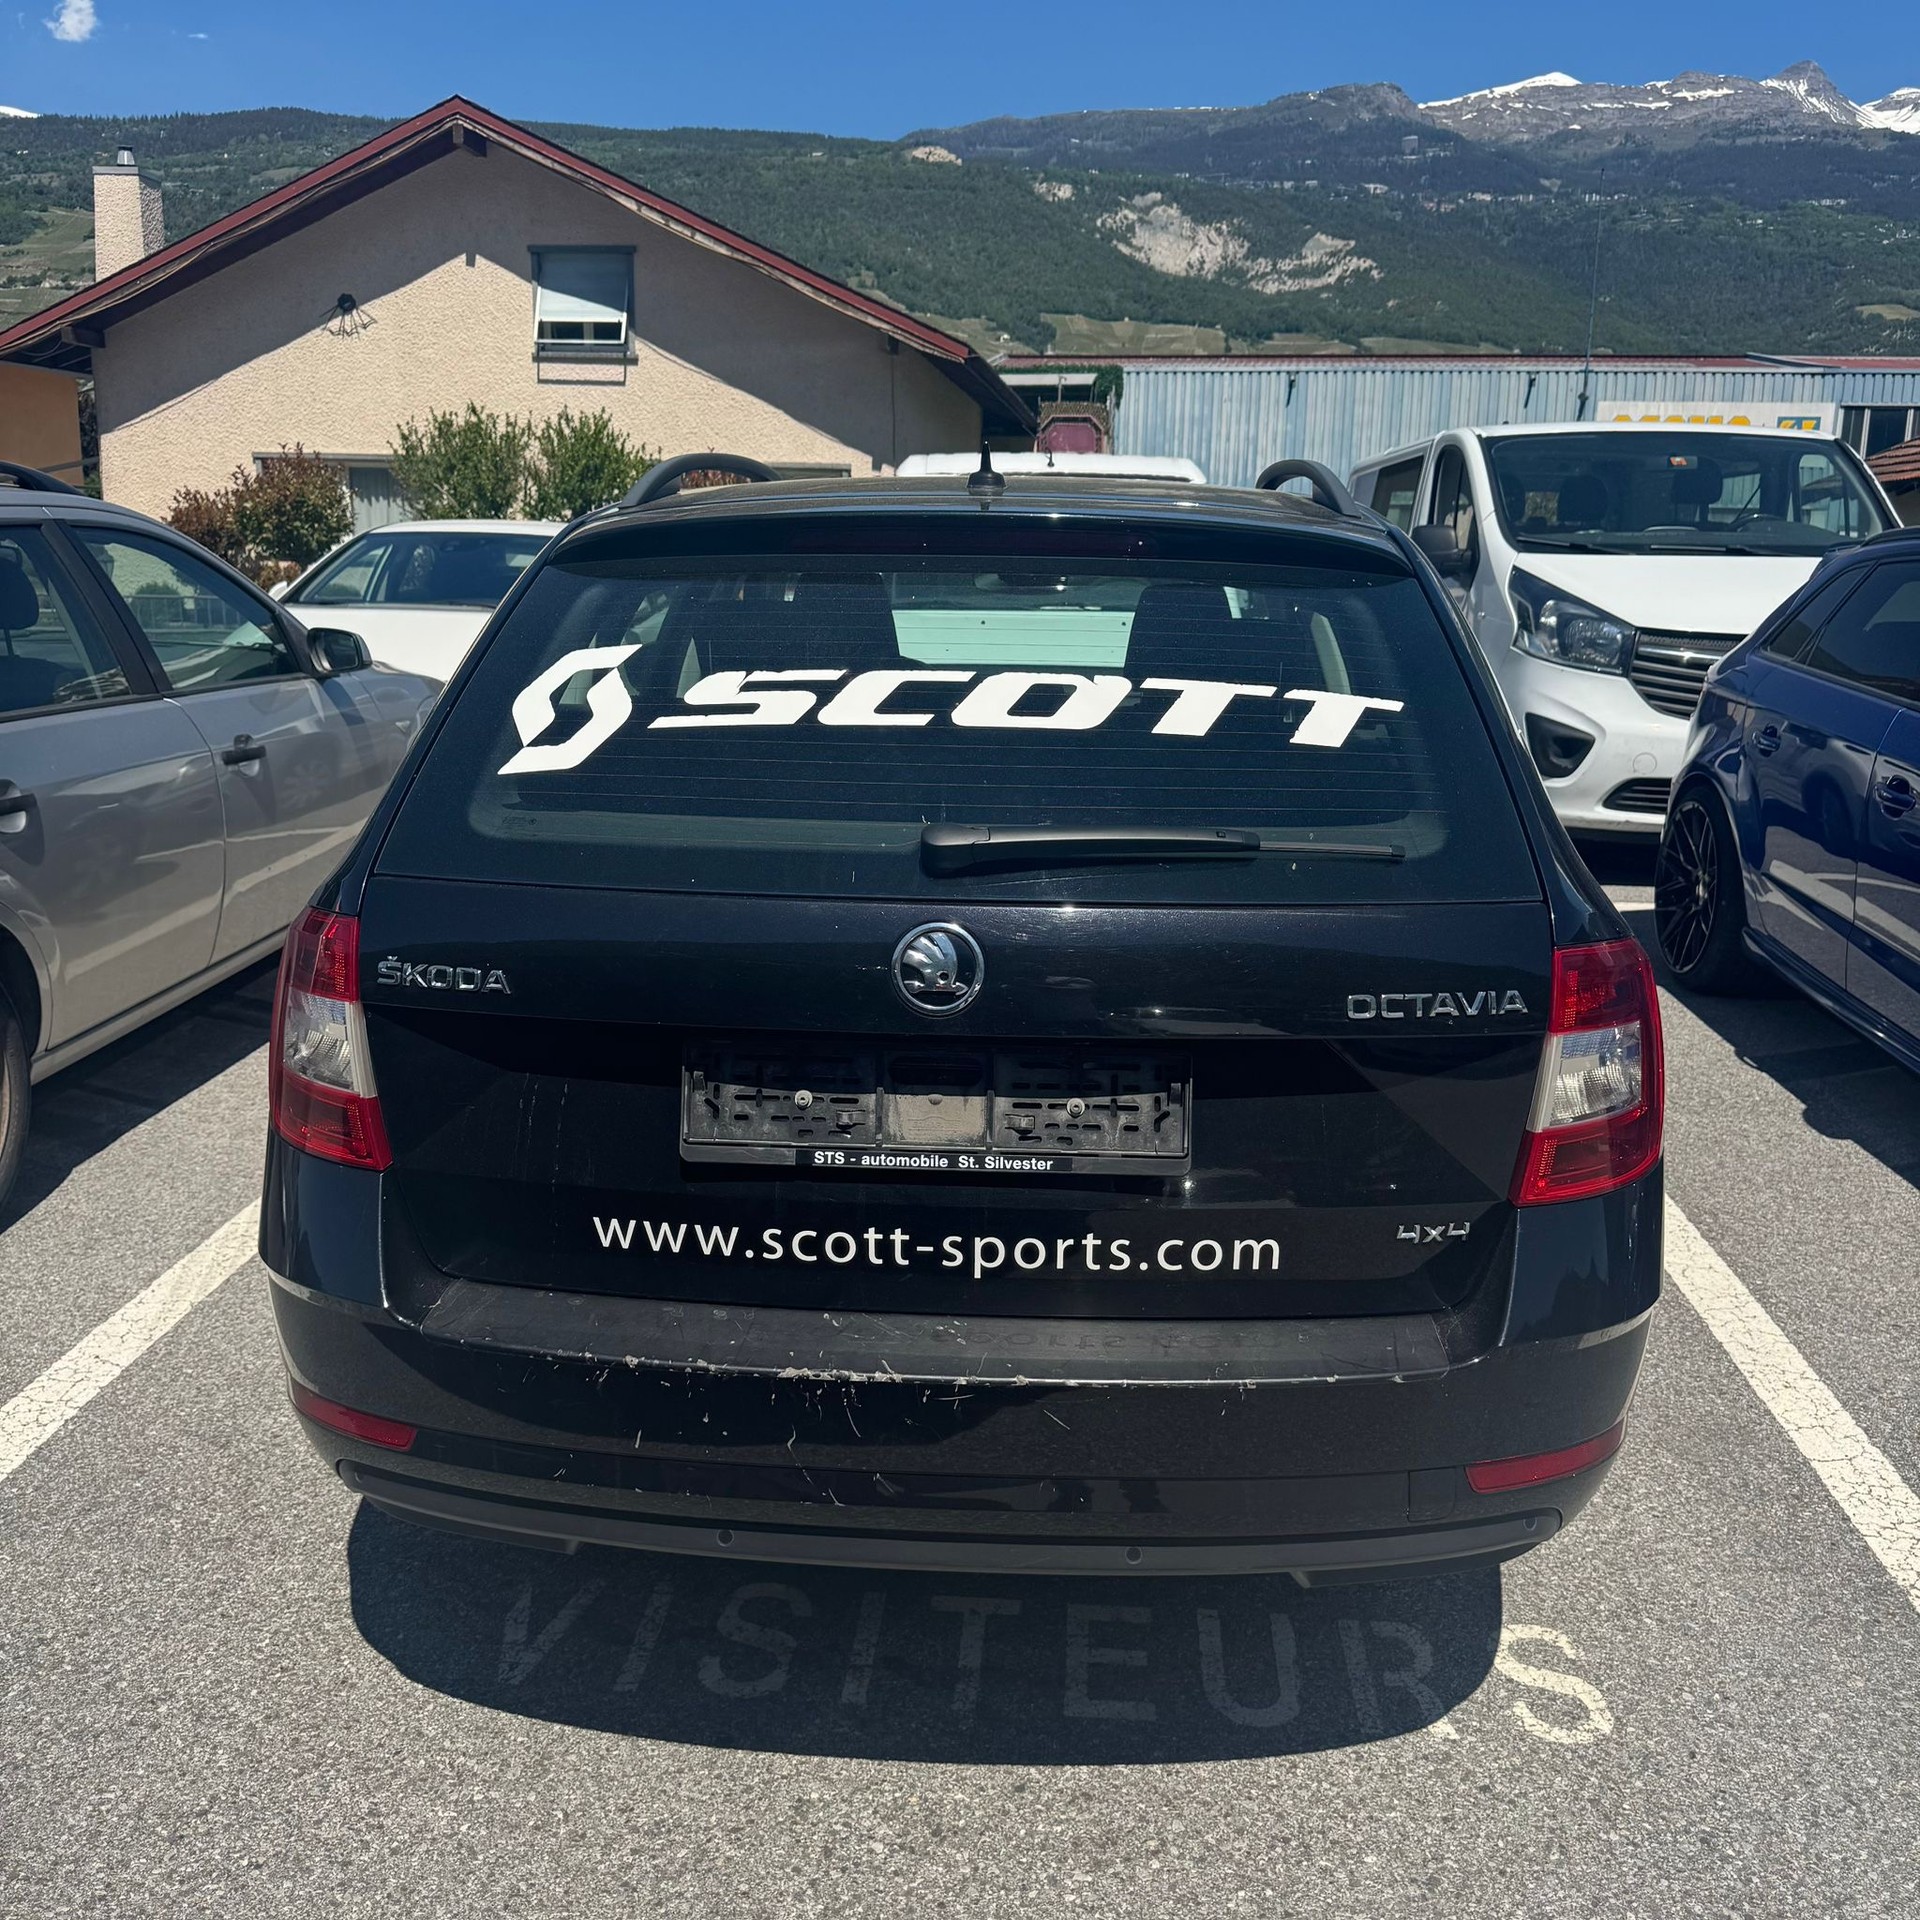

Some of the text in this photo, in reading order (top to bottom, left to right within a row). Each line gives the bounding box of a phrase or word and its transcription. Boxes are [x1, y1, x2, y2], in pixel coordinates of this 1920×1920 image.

[647, 669, 1404, 748] SCOTT
[376, 955, 512, 995] ŠKODA
[1346, 989, 1529, 1020] OCTAVIA
[813, 1151, 846, 1166] STS
[861, 1152, 949, 1169] automobile
[957, 1155, 980, 1169] St.
[984, 1155, 1054, 1171] Silvester
[592, 1216, 1280, 1279] www.scott-sports.com
[1396, 1221, 1471, 1245] 4x4
[497, 1577, 1615, 1745] VISITEURS
